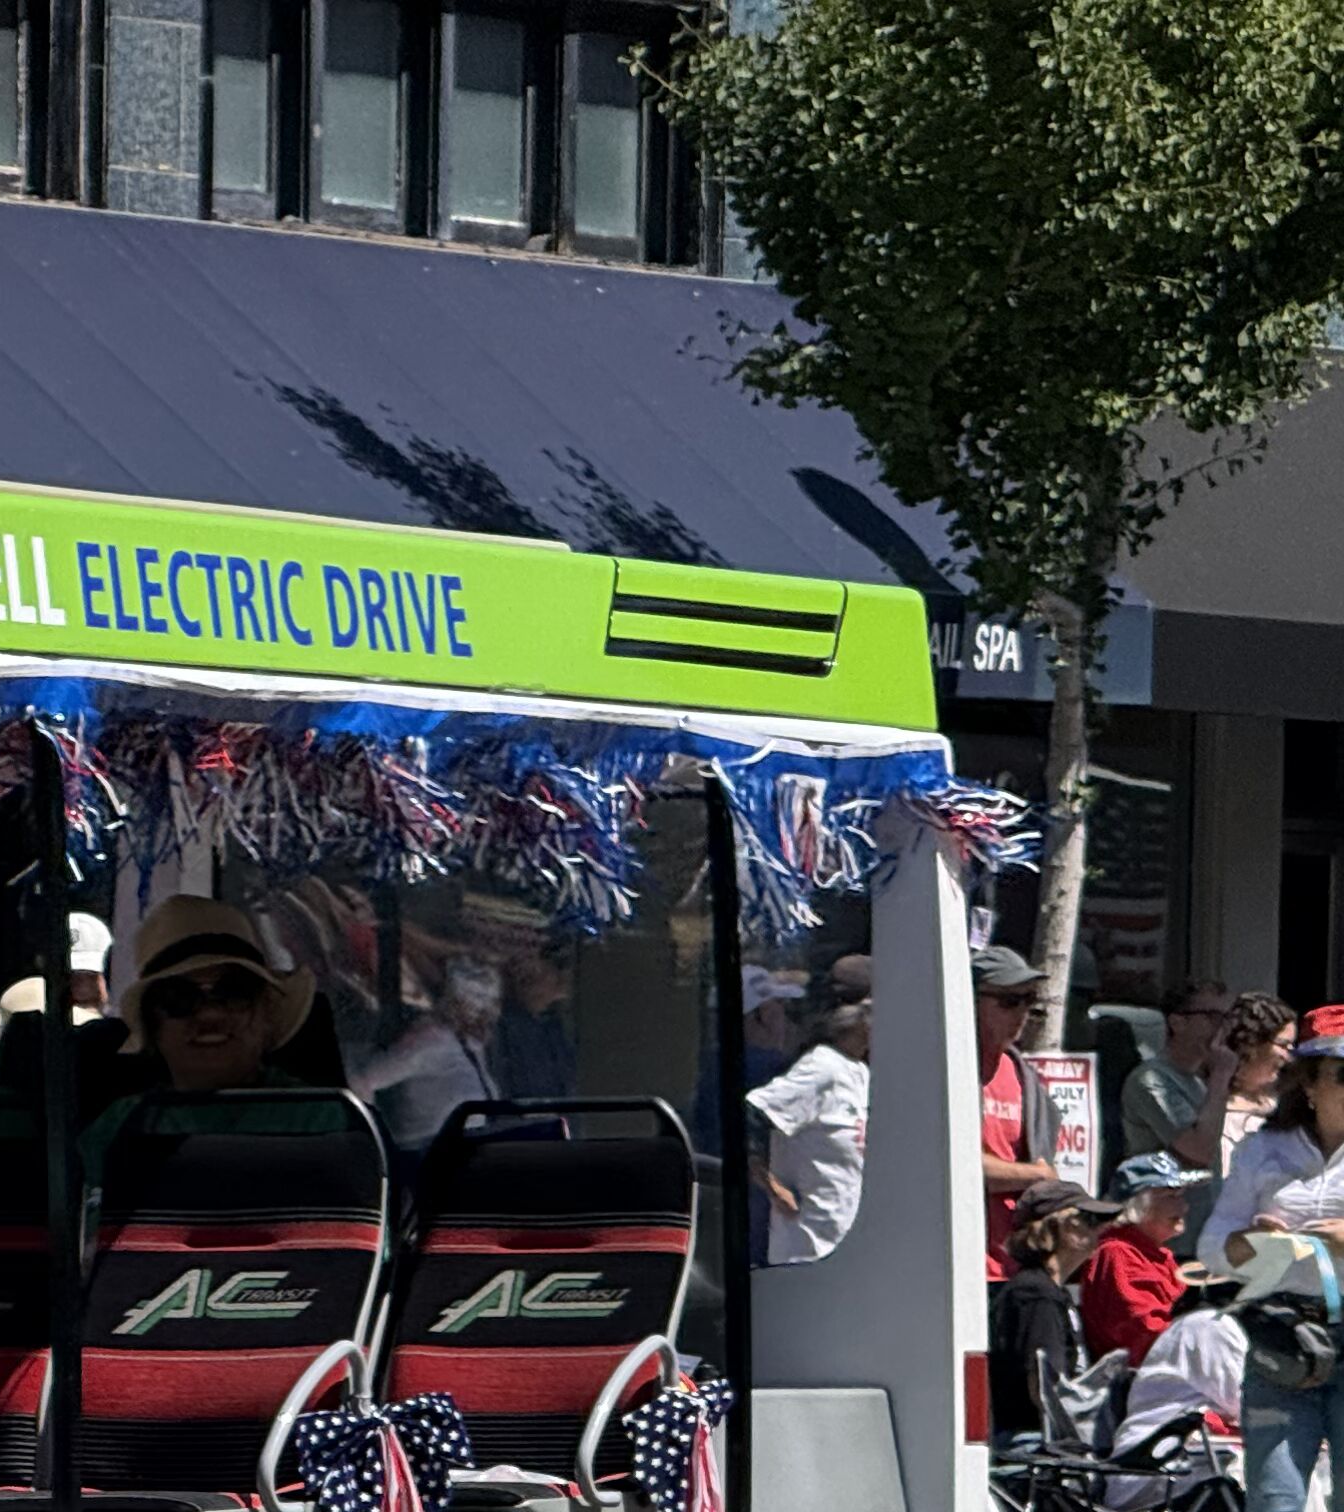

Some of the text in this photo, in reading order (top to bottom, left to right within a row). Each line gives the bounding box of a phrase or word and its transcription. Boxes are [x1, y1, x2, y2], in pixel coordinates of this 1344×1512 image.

[76, 541, 313, 647] ELECTRIC
[321, 564, 473, 658] DRIVE
[973, 623, 1023, 672] SPA
[1052, 1086, 1086, 1101] JULY
[112, 1269, 321, 1335] AC TRANSIT
[428, 1269, 631, 1333] AC TRANSIT
